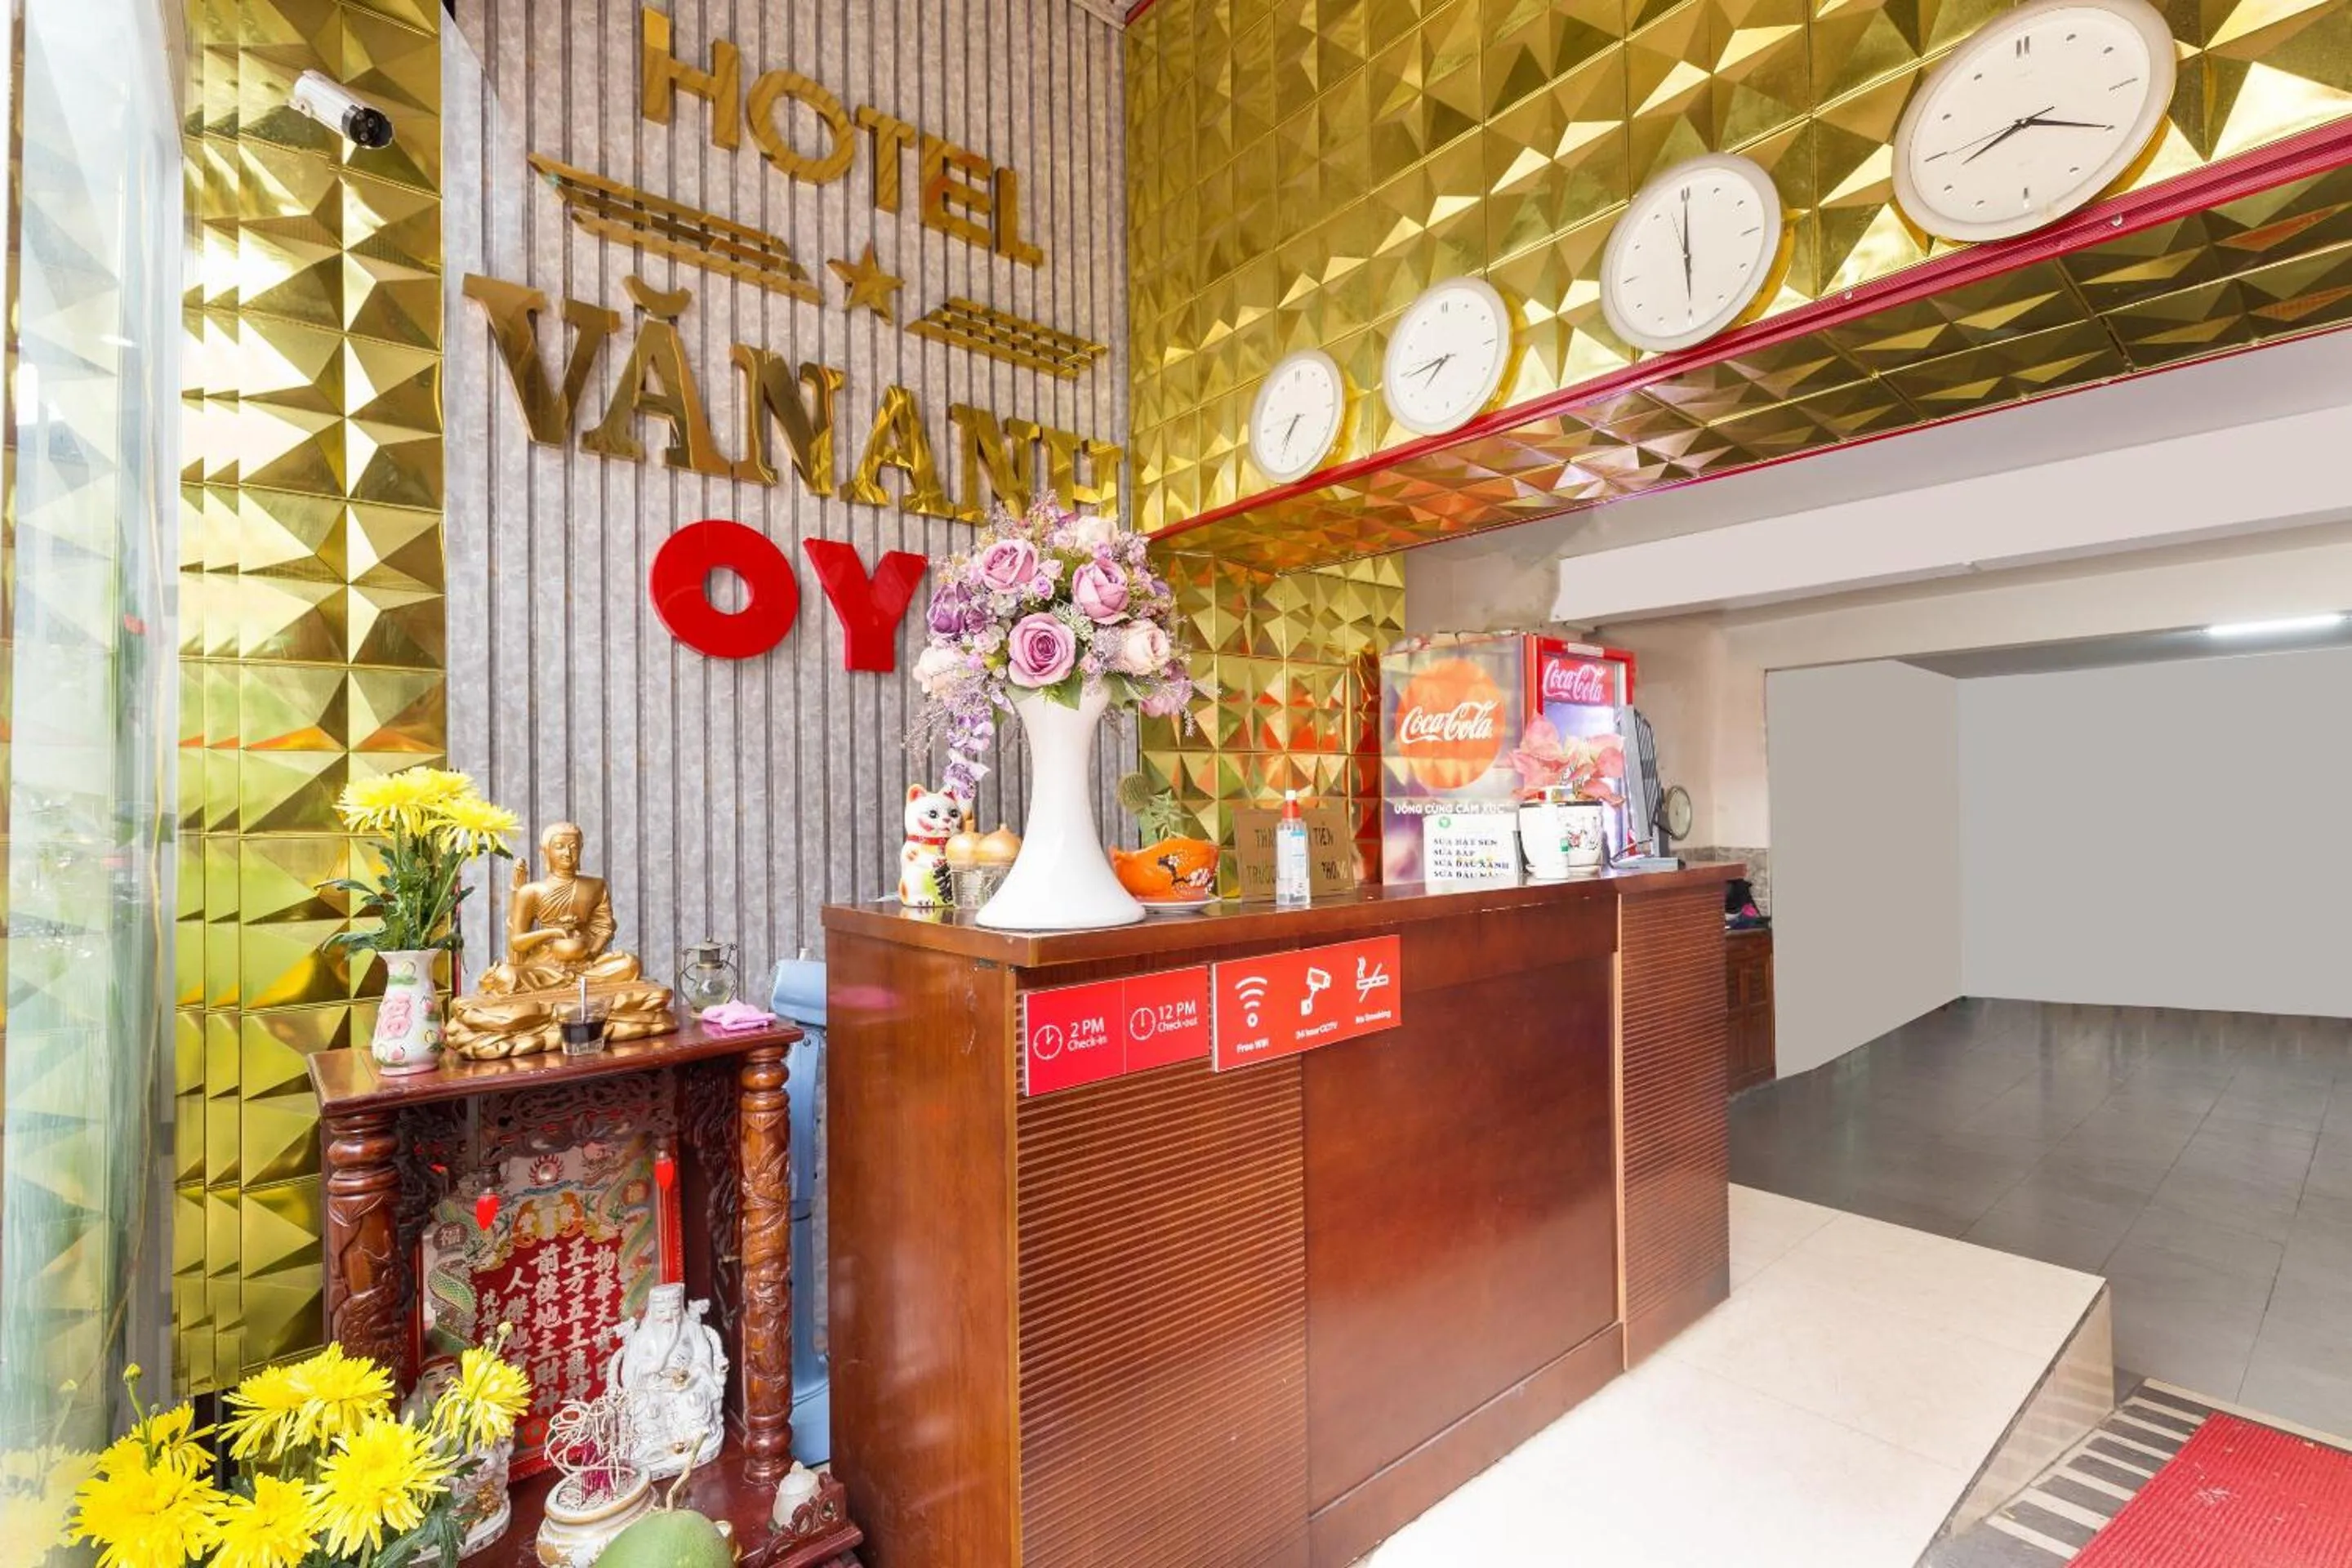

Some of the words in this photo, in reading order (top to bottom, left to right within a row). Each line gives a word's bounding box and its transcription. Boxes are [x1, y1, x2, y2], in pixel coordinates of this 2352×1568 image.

[641, 7, 1043, 267] HOTEL
[649, 519, 929, 672] OY
[1543, 659, 1606, 702] Coca-Cola
[1401, 700, 1498, 745] Coca-Cola
[1070, 1022, 1080, 1038] 2
[1082, 1017, 1105, 1035] PM
[1157, 1017, 1199, 1033] Check-out
[1158, 1004, 1173, 1021] 12
[1176, 1000, 1196, 1017] PM
